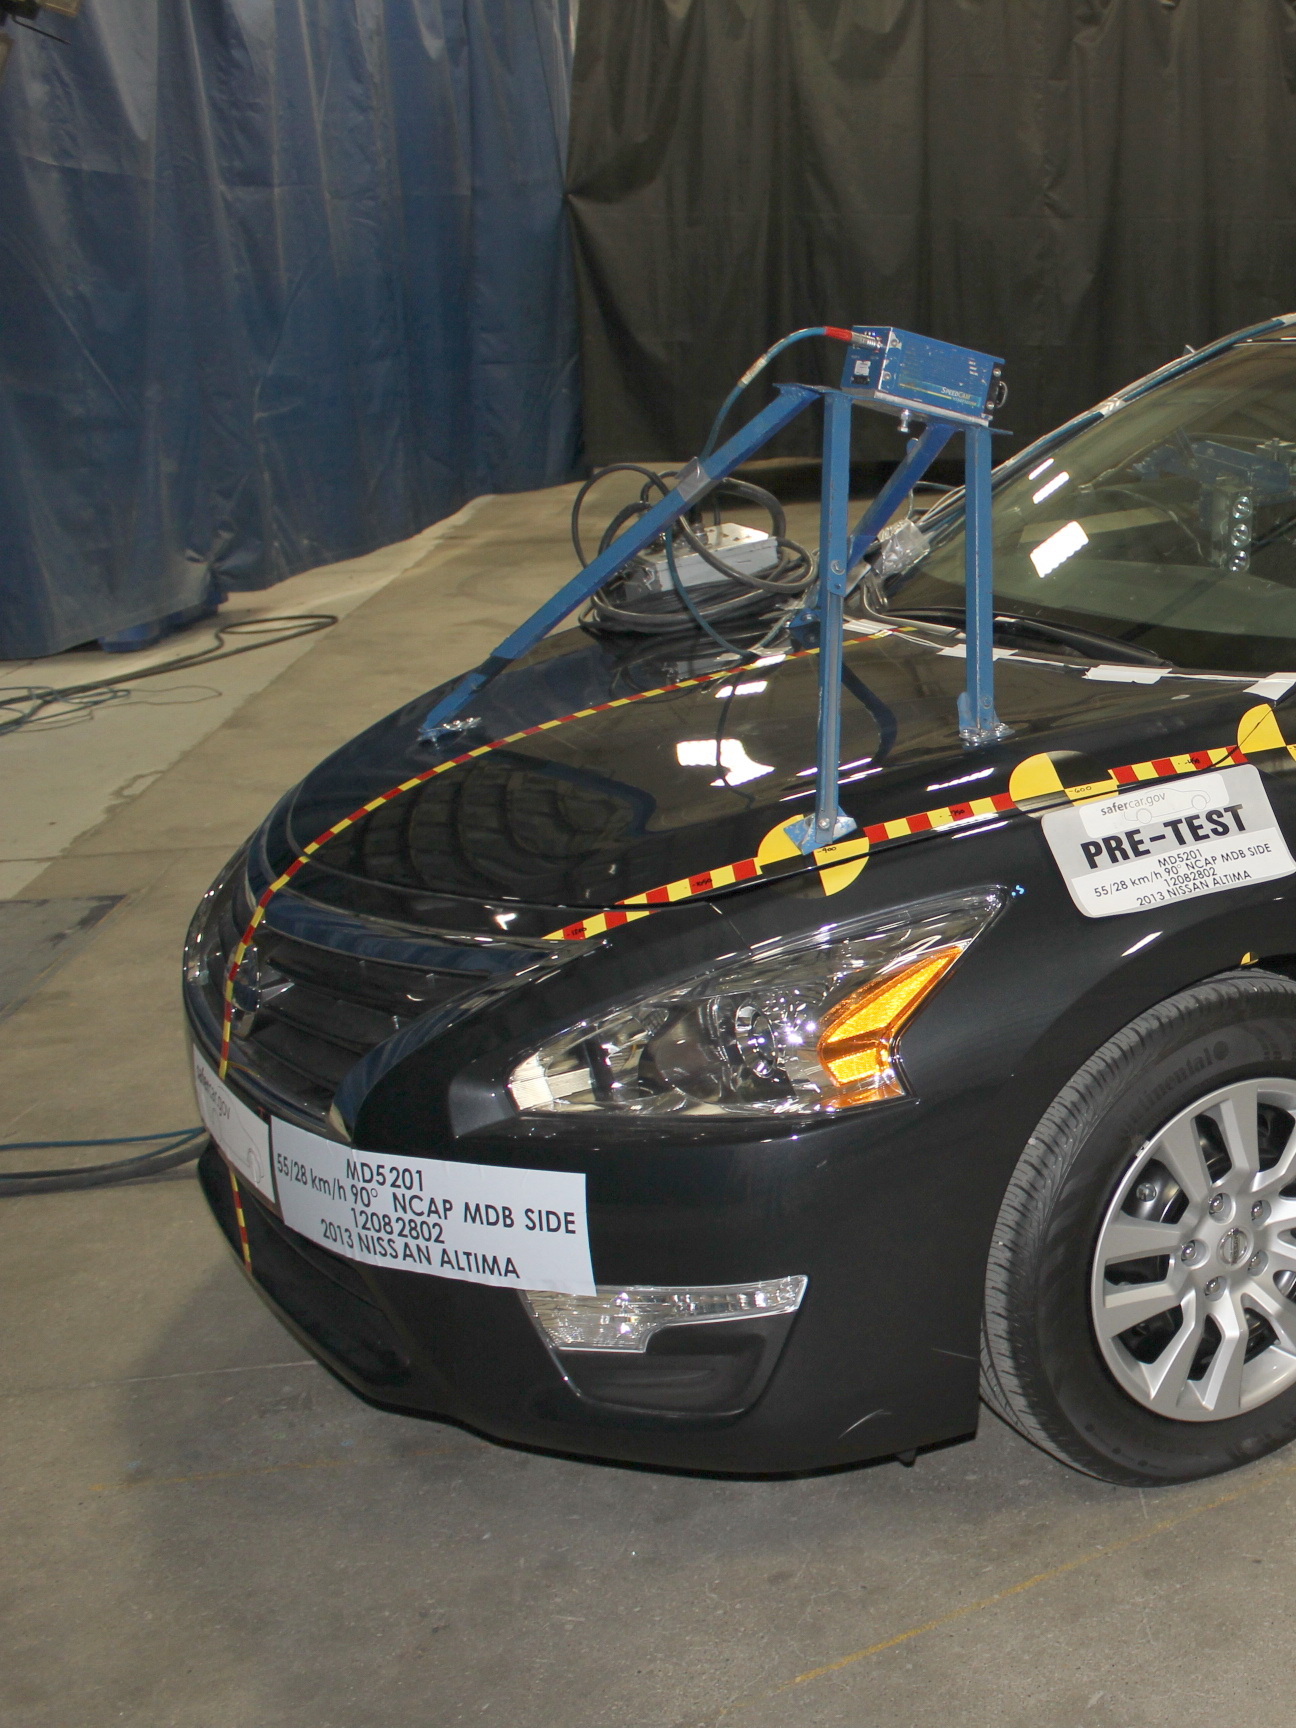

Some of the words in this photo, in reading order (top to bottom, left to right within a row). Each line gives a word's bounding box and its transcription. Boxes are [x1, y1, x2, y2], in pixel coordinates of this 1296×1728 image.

[1101, 793, 1166, 816] safercar.gov
[1080, 804, 1246, 869] PRE-TEST
[1094, 880, 1128, 897] 55/28
[1130, 870, 1163, 888] km/h
[1185, 856, 1217, 871] NCAP
[1221, 849, 1247, 863] MDB
[1247, 843, 1272, 856] SIDE
[1158, 848, 1202, 868] MD5201
[1136, 892, 1166, 906] 2013
[1166, 880, 1209, 899] NISSAN
[1212, 869, 1252, 887] ALTIMA
[1164, 867, 1217, 887] 12082802
[346, 1158, 424, 1191] MD5201
[276, 1153, 308, 1186] 55/28
[310, 1167, 347, 1202] km/h
[393, 1192, 454, 1220] NCAP
[464, 1202, 514, 1228] MDB
[525, 1208, 577, 1234] SIDE
[351, 1208, 446, 1244] 12082802
[320, 1219, 354, 1248] 2013
[359, 1233, 432, 1266] NISSAN
[440, 1249, 521, 1279] ALTIMA
